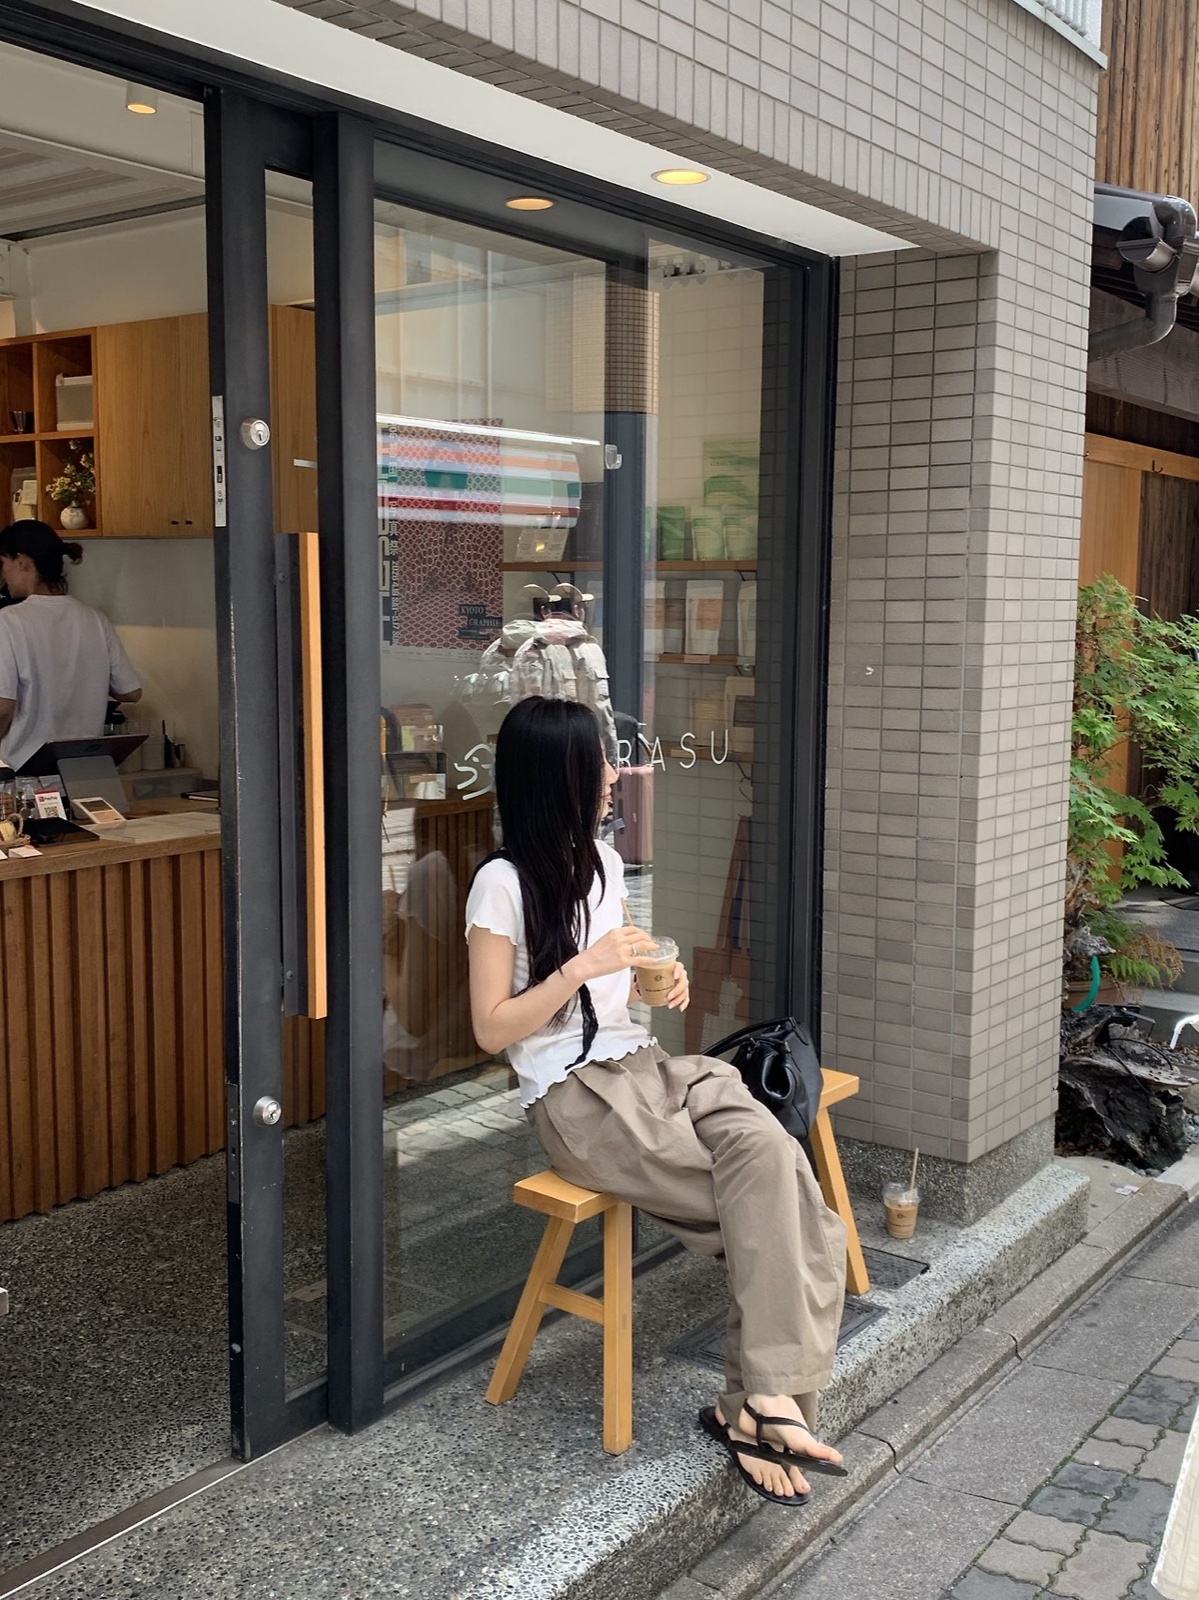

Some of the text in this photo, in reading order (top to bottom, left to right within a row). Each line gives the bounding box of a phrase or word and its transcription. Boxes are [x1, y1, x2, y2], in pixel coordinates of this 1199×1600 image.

[460, 605, 484, 615] KYOTO
[468, 618, 501, 627] GRAPHIE
[616, 730, 729, 776] RASU
